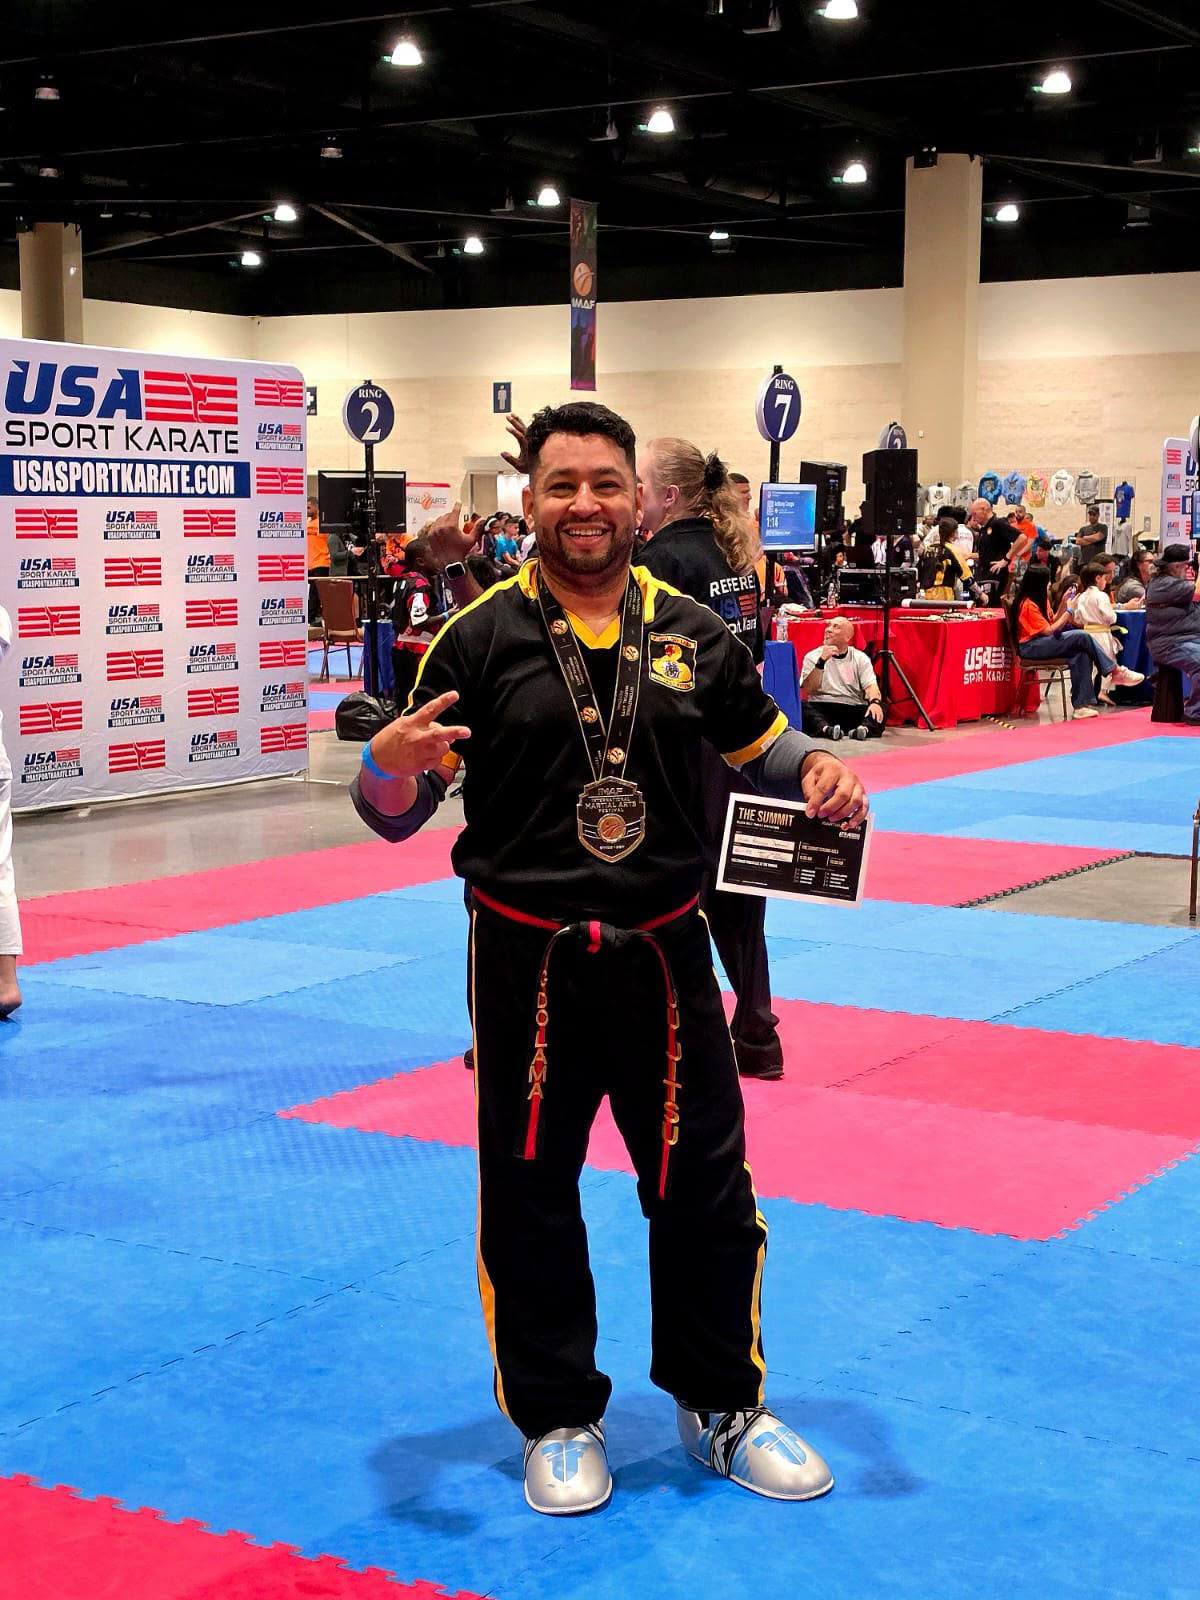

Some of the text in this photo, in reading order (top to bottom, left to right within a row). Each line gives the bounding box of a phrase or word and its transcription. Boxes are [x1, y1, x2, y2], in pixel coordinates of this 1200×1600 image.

[5, 360, 143, 420] USA
[774, 379, 794, 390] RING
[358, 389, 383, 398] RING
[360, 401, 381, 440] 2
[774, 393, 793, 438] 7
[258, 423, 283, 434] USA
[5, 420, 239, 454] SPORT KARATE
[12, 459, 235, 495] USASPORTKARATE.COM
[106, 510, 135, 523] USA
[260, 511, 284, 522] USA
[20, 558, 52, 571] USA
[187, 554, 214, 566] USA
[709, 574, 756, 598] REFERE
[261, 598, 285, 609] USA
[109, 604, 138, 617] USA
[190, 644, 216, 656] USA
[22, 655, 54, 669] USA
[964, 646, 992, 671] USA
[262, 683, 286, 696] USA
[110, 697, 140, 710] USA
[191, 732, 217, 746] USA
[24, 751, 56, 766] USA
[738, 807, 756, 821] THE
[757, 810, 795, 827] SUMMIT
